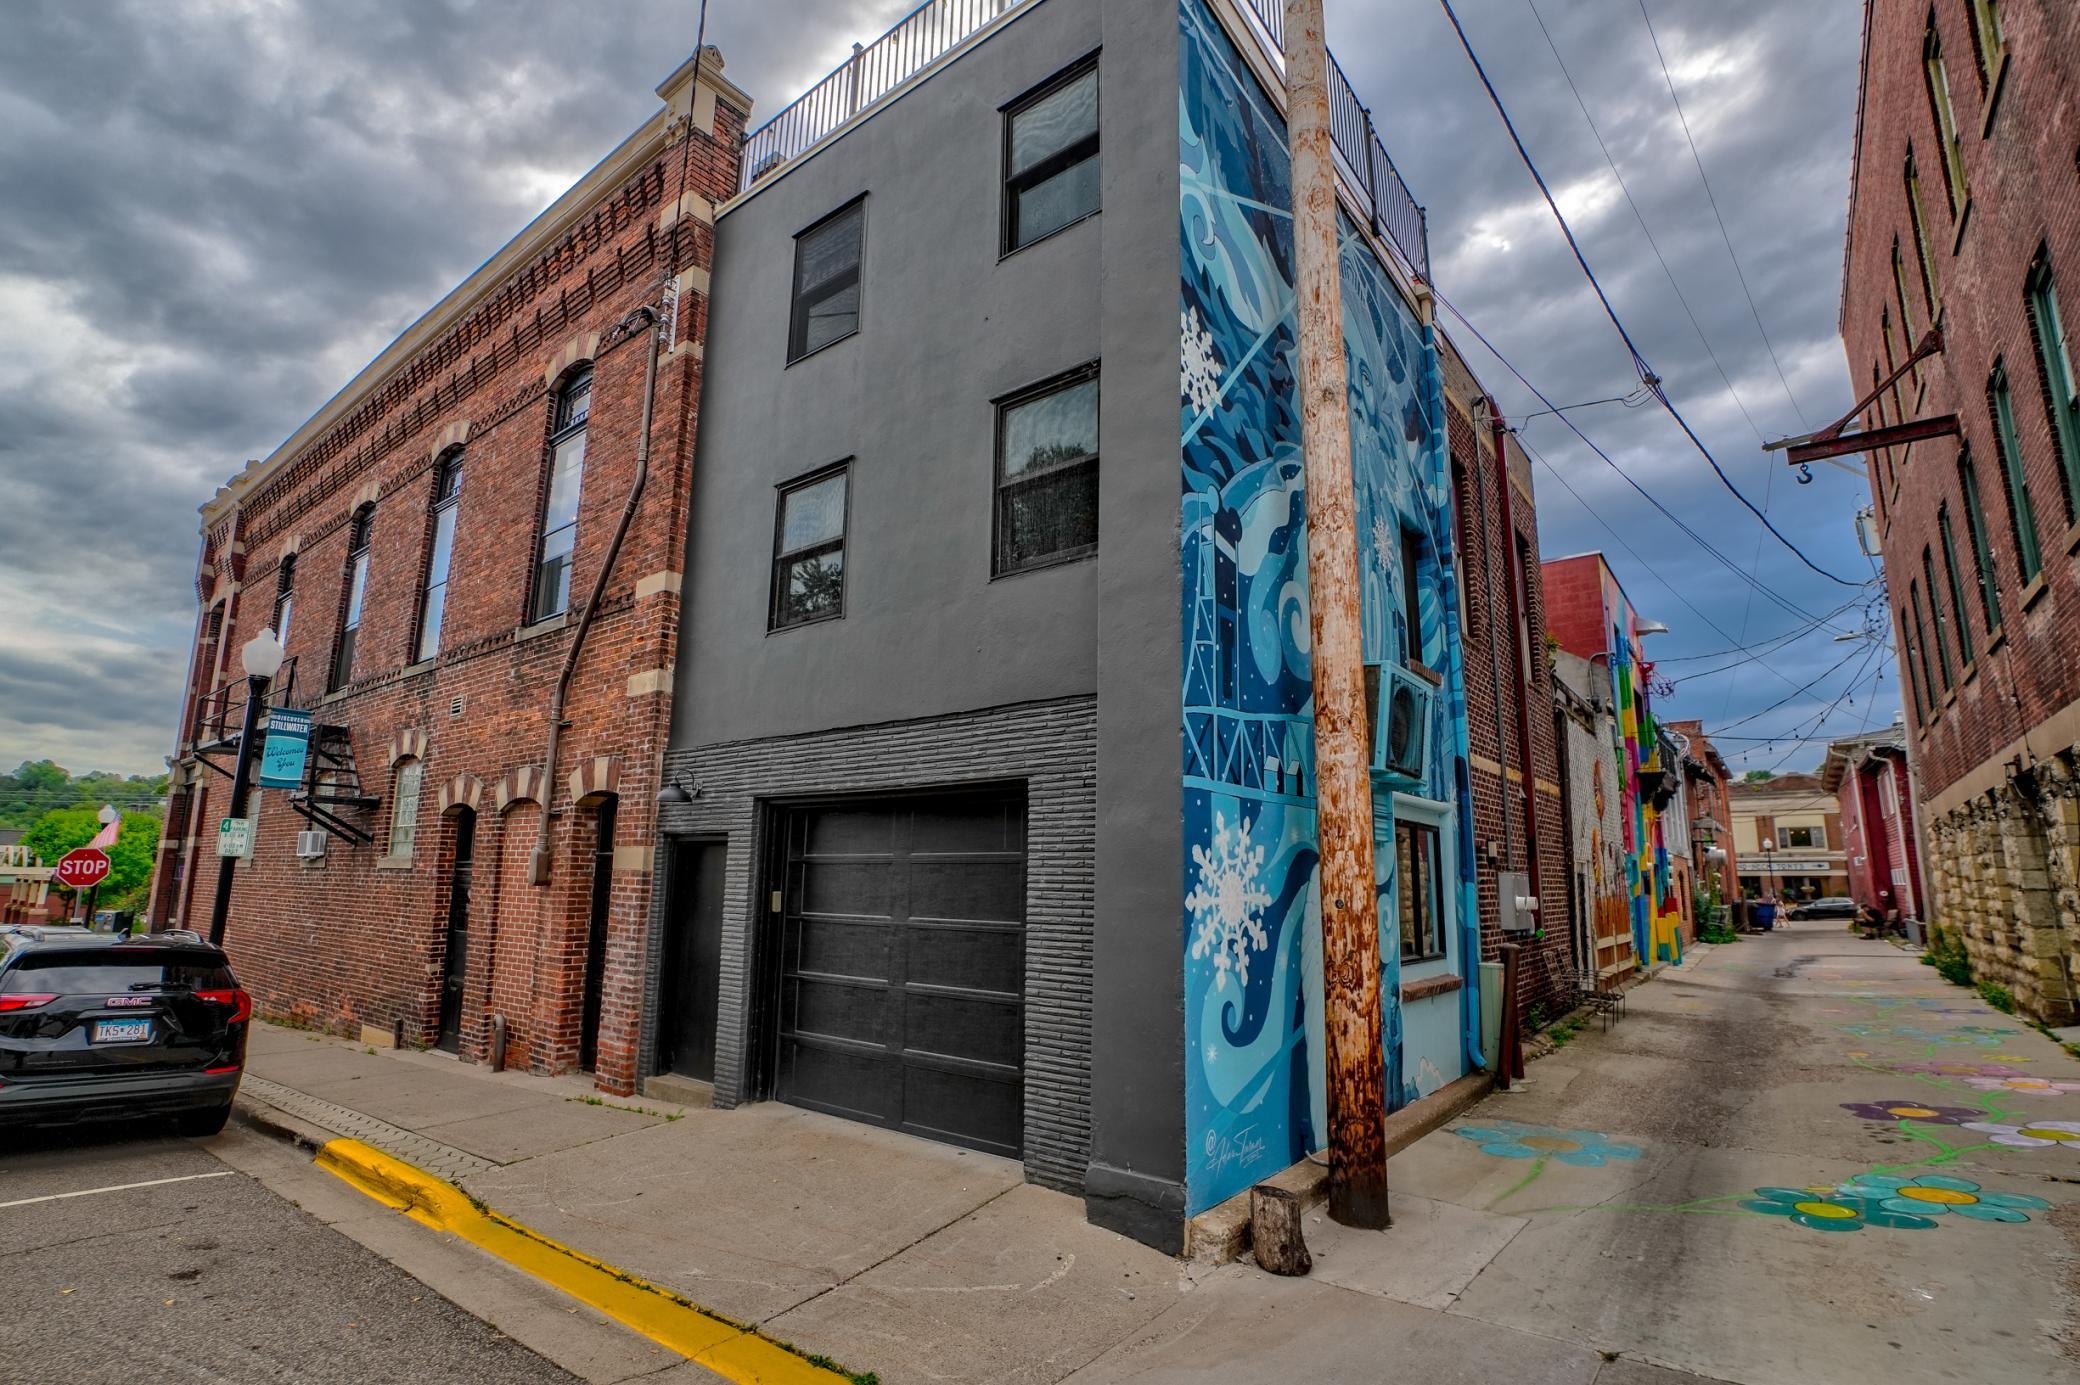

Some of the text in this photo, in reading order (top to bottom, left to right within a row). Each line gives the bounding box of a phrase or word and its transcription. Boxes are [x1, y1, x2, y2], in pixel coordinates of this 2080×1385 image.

[270, 720, 308, 733] STILLWATER
[276, 757, 295, 772] You
[223, 821, 230, 830] 4
[61, 860, 107, 875] STOP
[107, 996, 152, 1006] GMC
